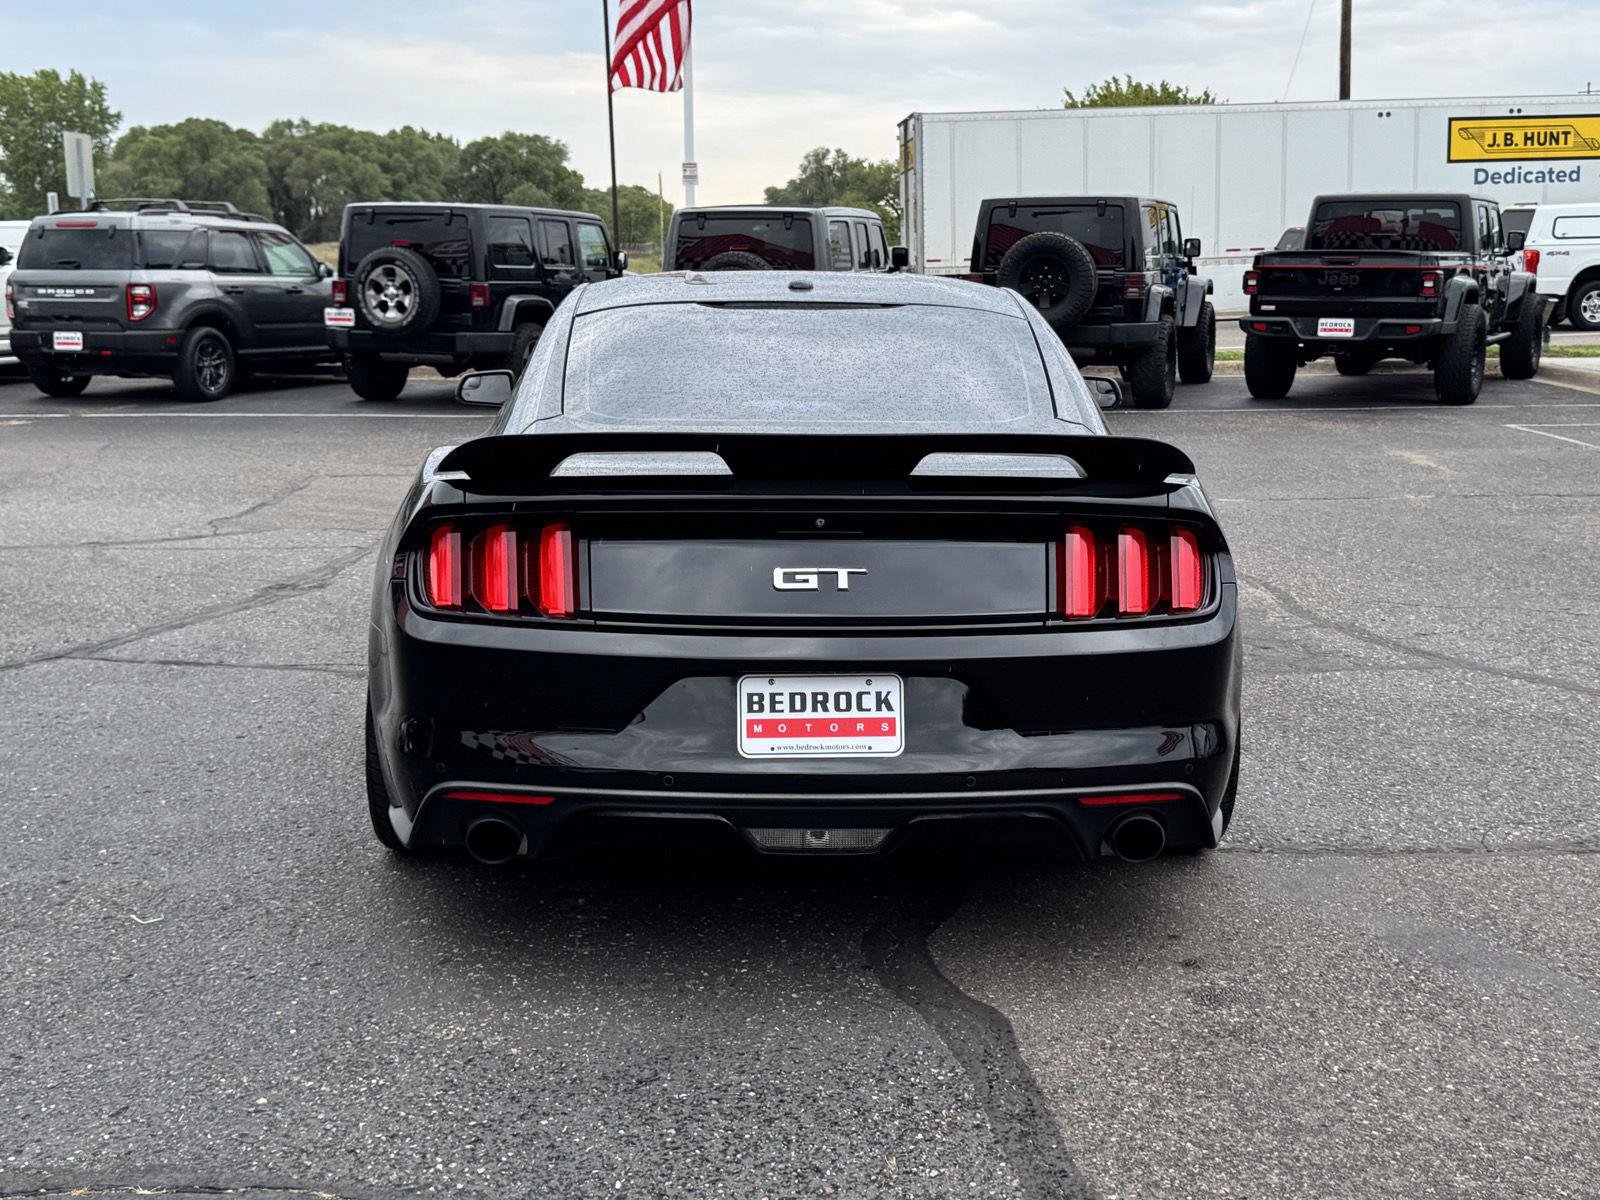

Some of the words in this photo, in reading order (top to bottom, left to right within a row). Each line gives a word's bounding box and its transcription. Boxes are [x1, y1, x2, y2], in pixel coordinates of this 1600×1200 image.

[1523, 131, 1571, 147] HUNT
[1473, 165, 1581, 185] Dedicated
[1317, 271, 1360, 287] Jeep
[773, 567, 868, 592] GT
[746, 691, 895, 714] BEDROCK
[753, 722, 890, 734] MOTORS
[776, 743, 867, 751] www.bedrockmotors.com
